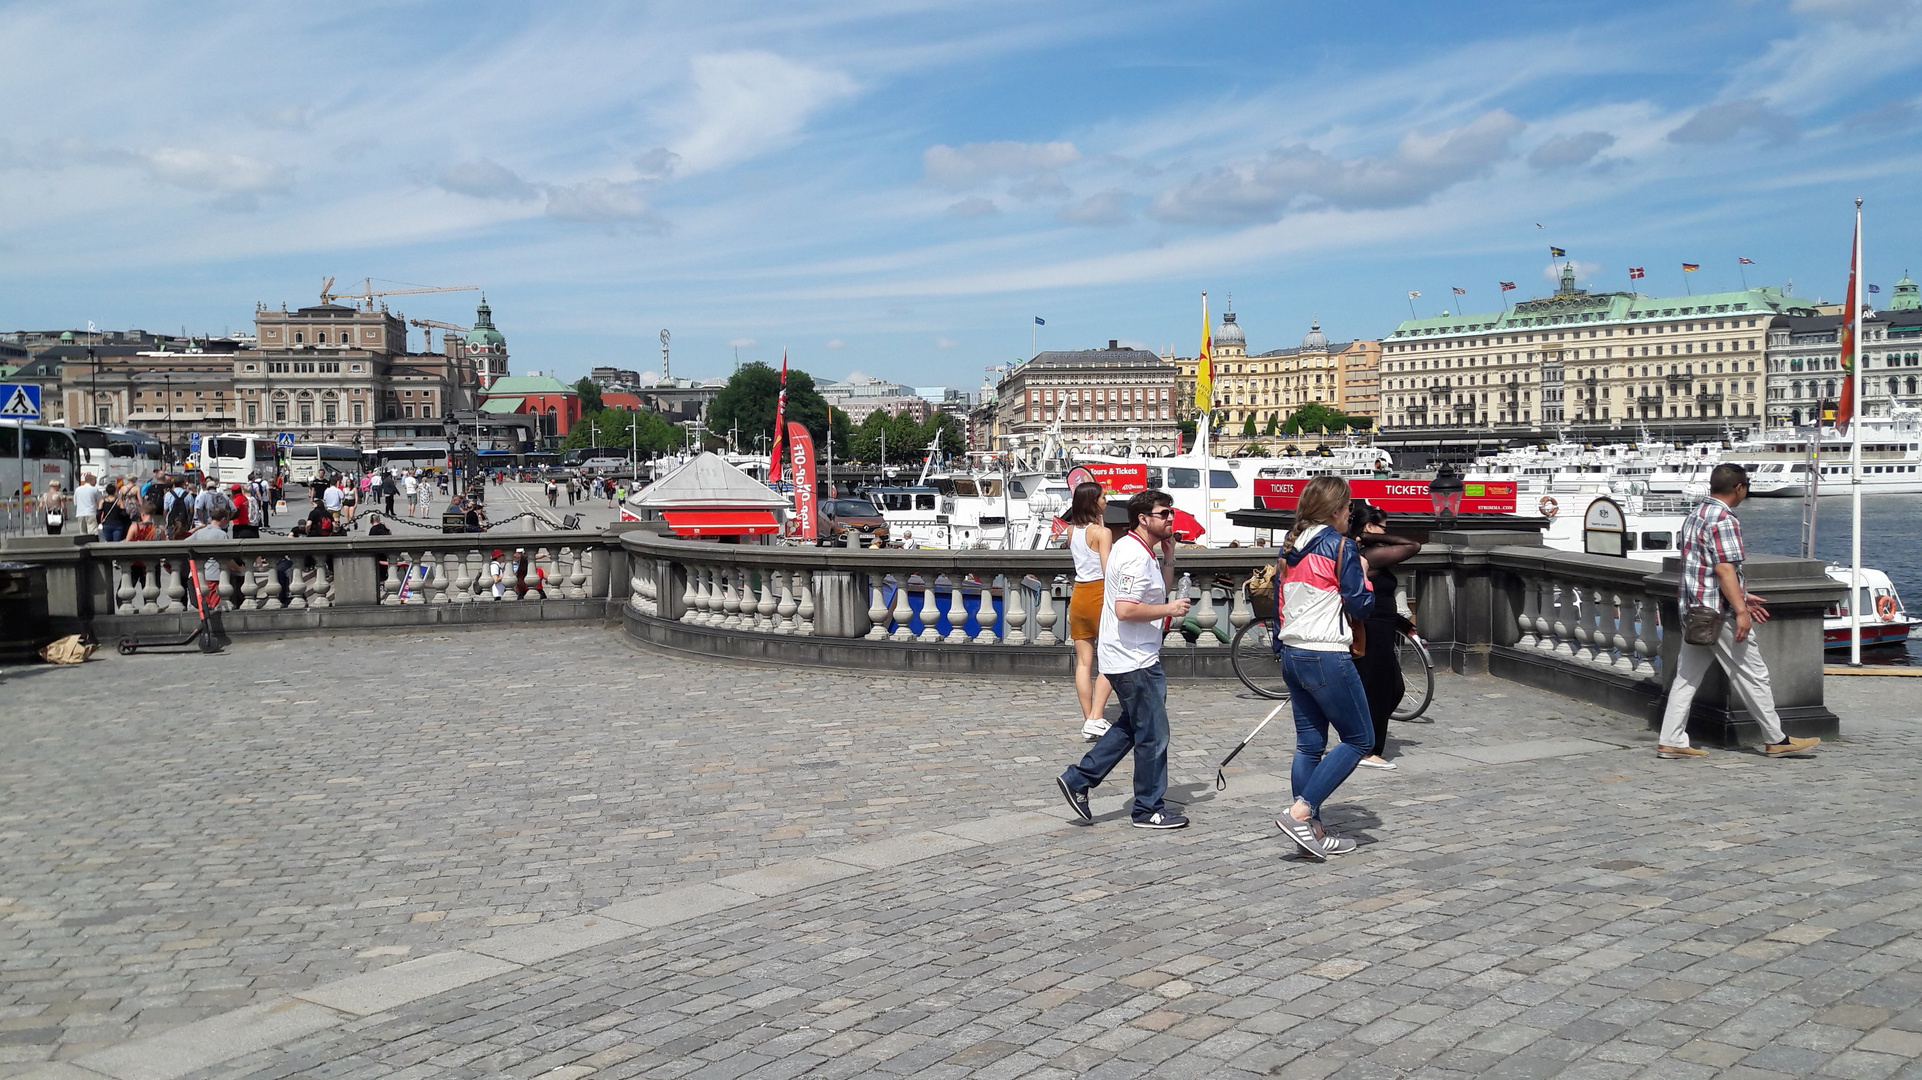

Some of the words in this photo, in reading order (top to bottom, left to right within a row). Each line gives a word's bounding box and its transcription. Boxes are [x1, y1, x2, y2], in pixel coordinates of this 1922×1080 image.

[1115, 467, 1138, 475] Tickets
[1270, 484, 1294, 493] TICKETS
[1385, 485, 1429, 495] TICKETS
